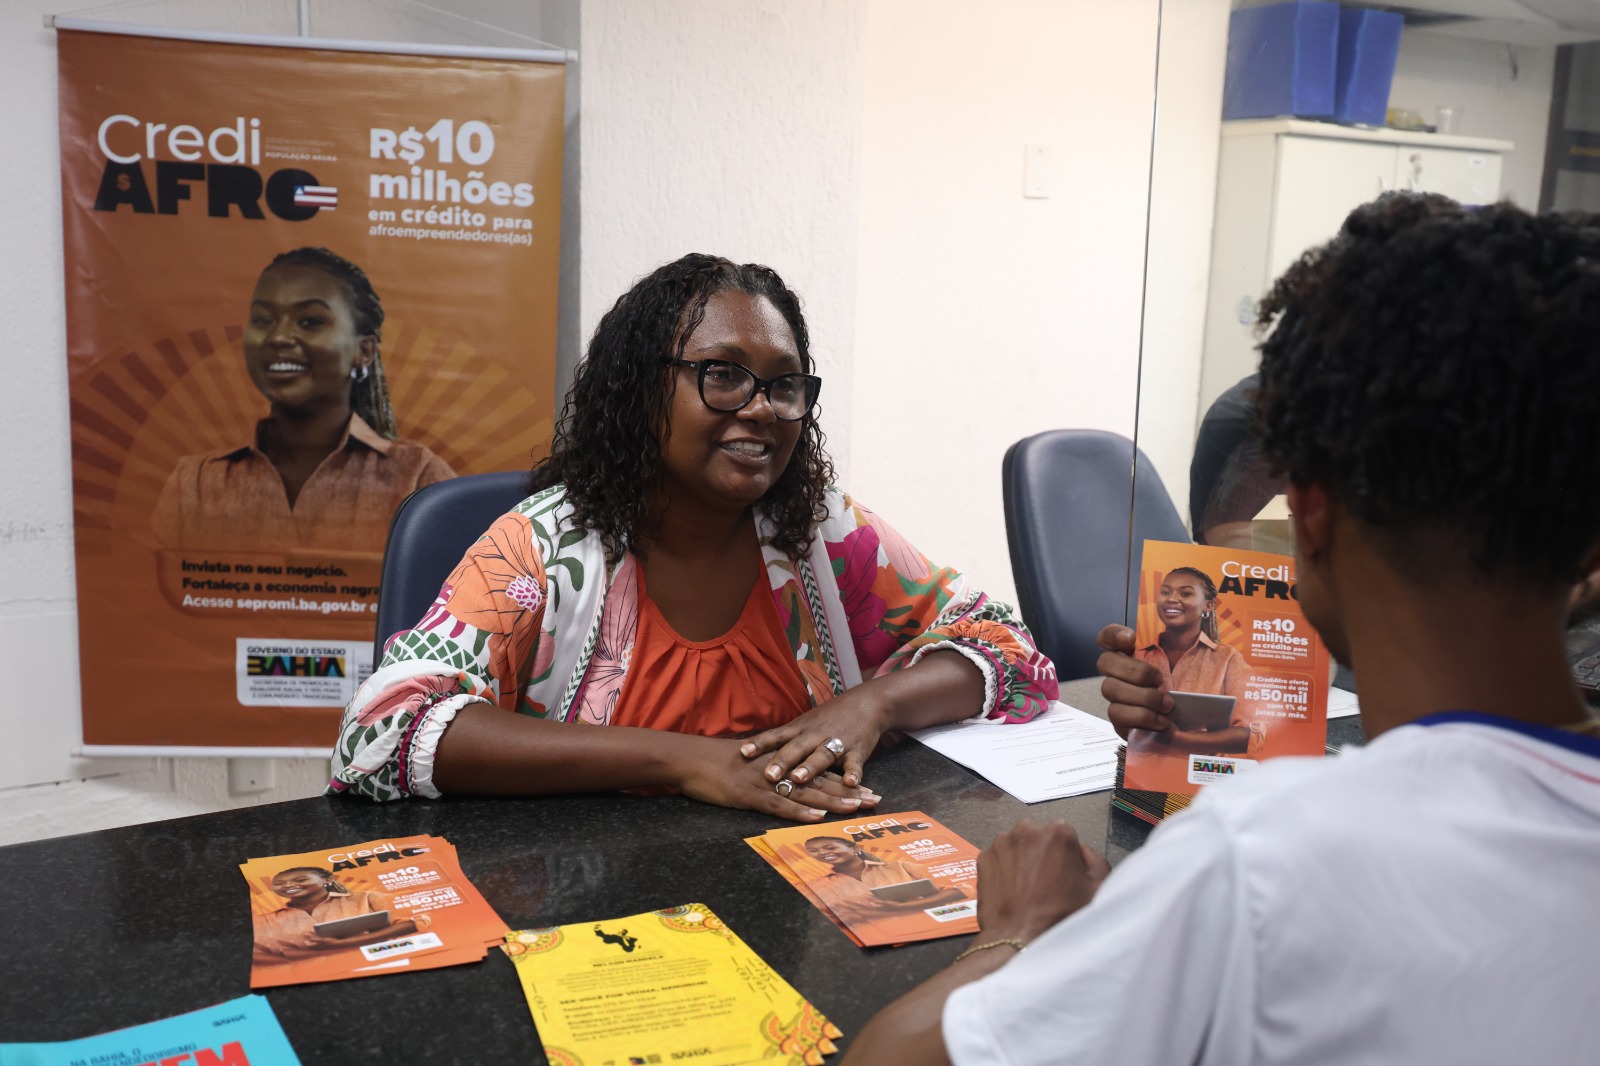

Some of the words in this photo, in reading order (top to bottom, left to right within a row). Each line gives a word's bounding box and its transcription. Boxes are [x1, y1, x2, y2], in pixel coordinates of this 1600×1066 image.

[98, 114, 261, 165] Credi
[370, 118, 494, 165] R$10
[93, 160, 322, 221] AFRO
[370, 166, 534, 207] milhões
[368, 209, 396, 222] em
[401, 205, 486, 226] crédito
[493, 217, 532, 231] para
[368, 225, 532, 246] afroempreendedores(as)
[182, 560, 231, 573] Invista
[235, 563, 253, 573] no
[257, 565, 283, 575] seu
[286, 562, 348, 578] negócio.
[1222, 561, 1289, 582] Credi
[182, 577, 250, 593] Fortaleça
[254, 583, 263, 591] a
[266, 581, 336, 594] economia
[182, 594, 234, 608] Acesse
[237, 597, 367, 614] sepromi.ba.gov.br
[1253, 618, 1295, 632] R$10
[1252, 631, 1308, 645] milhões
[247, 646, 292, 655] GOVERNO
[295, 647, 308, 655] DO
[310, 647, 345, 656] ESTADO
[1262, 643, 1291, 651] crédito
[247, 655, 346, 677] BAHIA
[1246, 682, 1287, 691] empréstimos
[1257, 676, 1288, 684] CrediAfro
[1244, 688, 1282, 702] R$50
[1283, 690, 1308, 705] mil
[1255, 708, 1276, 717] juros
[1288, 711, 1307, 719] mês.
[1193, 761, 1236, 774] BAHIA
[843, 818, 902, 834] Credi
[851, 822, 932, 842] AFRO
[328, 842, 396, 863] Credi
[898, 839, 933, 851] R$10
[906, 844, 952, 855] milhões
[333, 847, 428, 872] AFRO
[378, 866, 419, 880] R$10
[381, 870, 437, 884] milhões
[395, 896, 432, 909] R$50
[433, 889, 458, 901] mil
